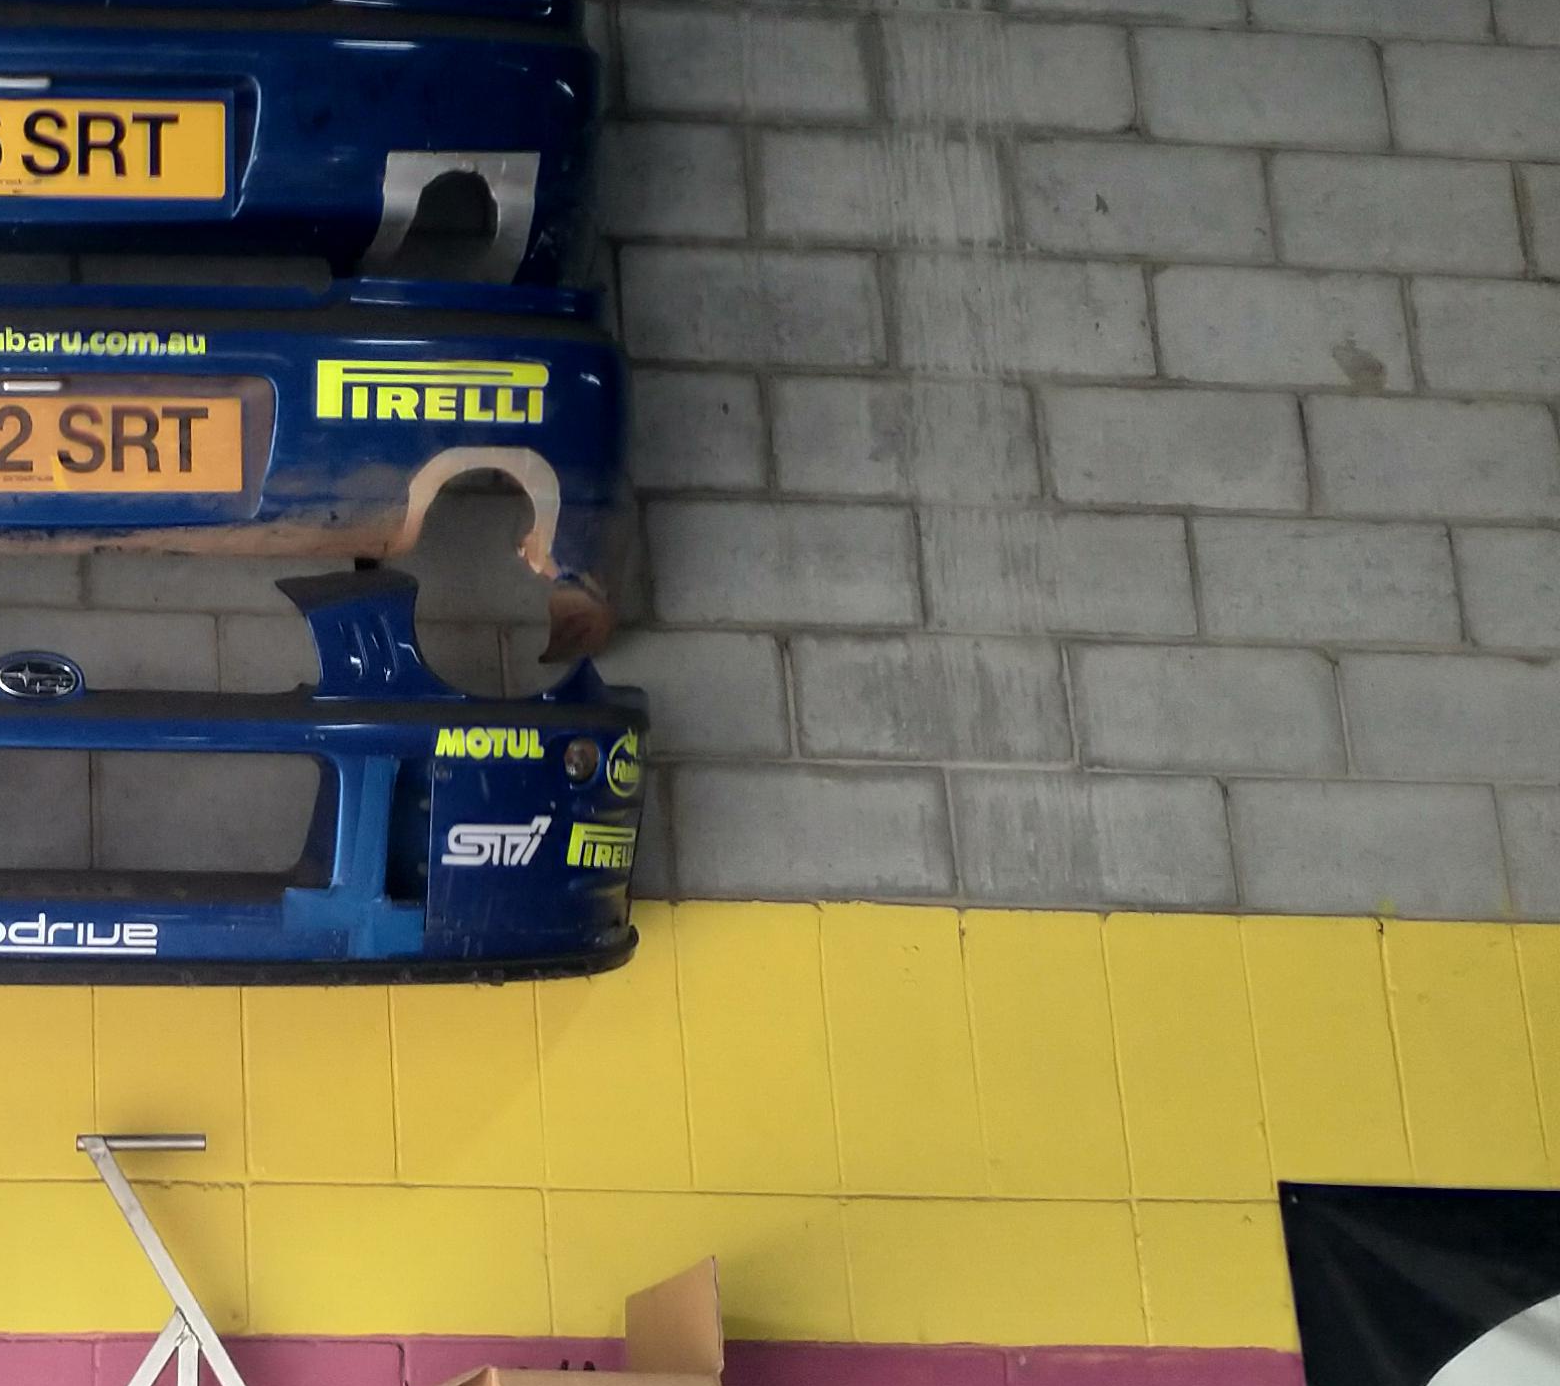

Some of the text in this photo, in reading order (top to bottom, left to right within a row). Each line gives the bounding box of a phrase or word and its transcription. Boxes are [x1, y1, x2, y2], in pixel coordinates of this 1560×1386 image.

[20, 111, 180, 178] SRT
[317, 359, 549, 423] PIRELLI
[58, 405, 209, 474] SRT
[435, 726, 545, 759] MOTUL
